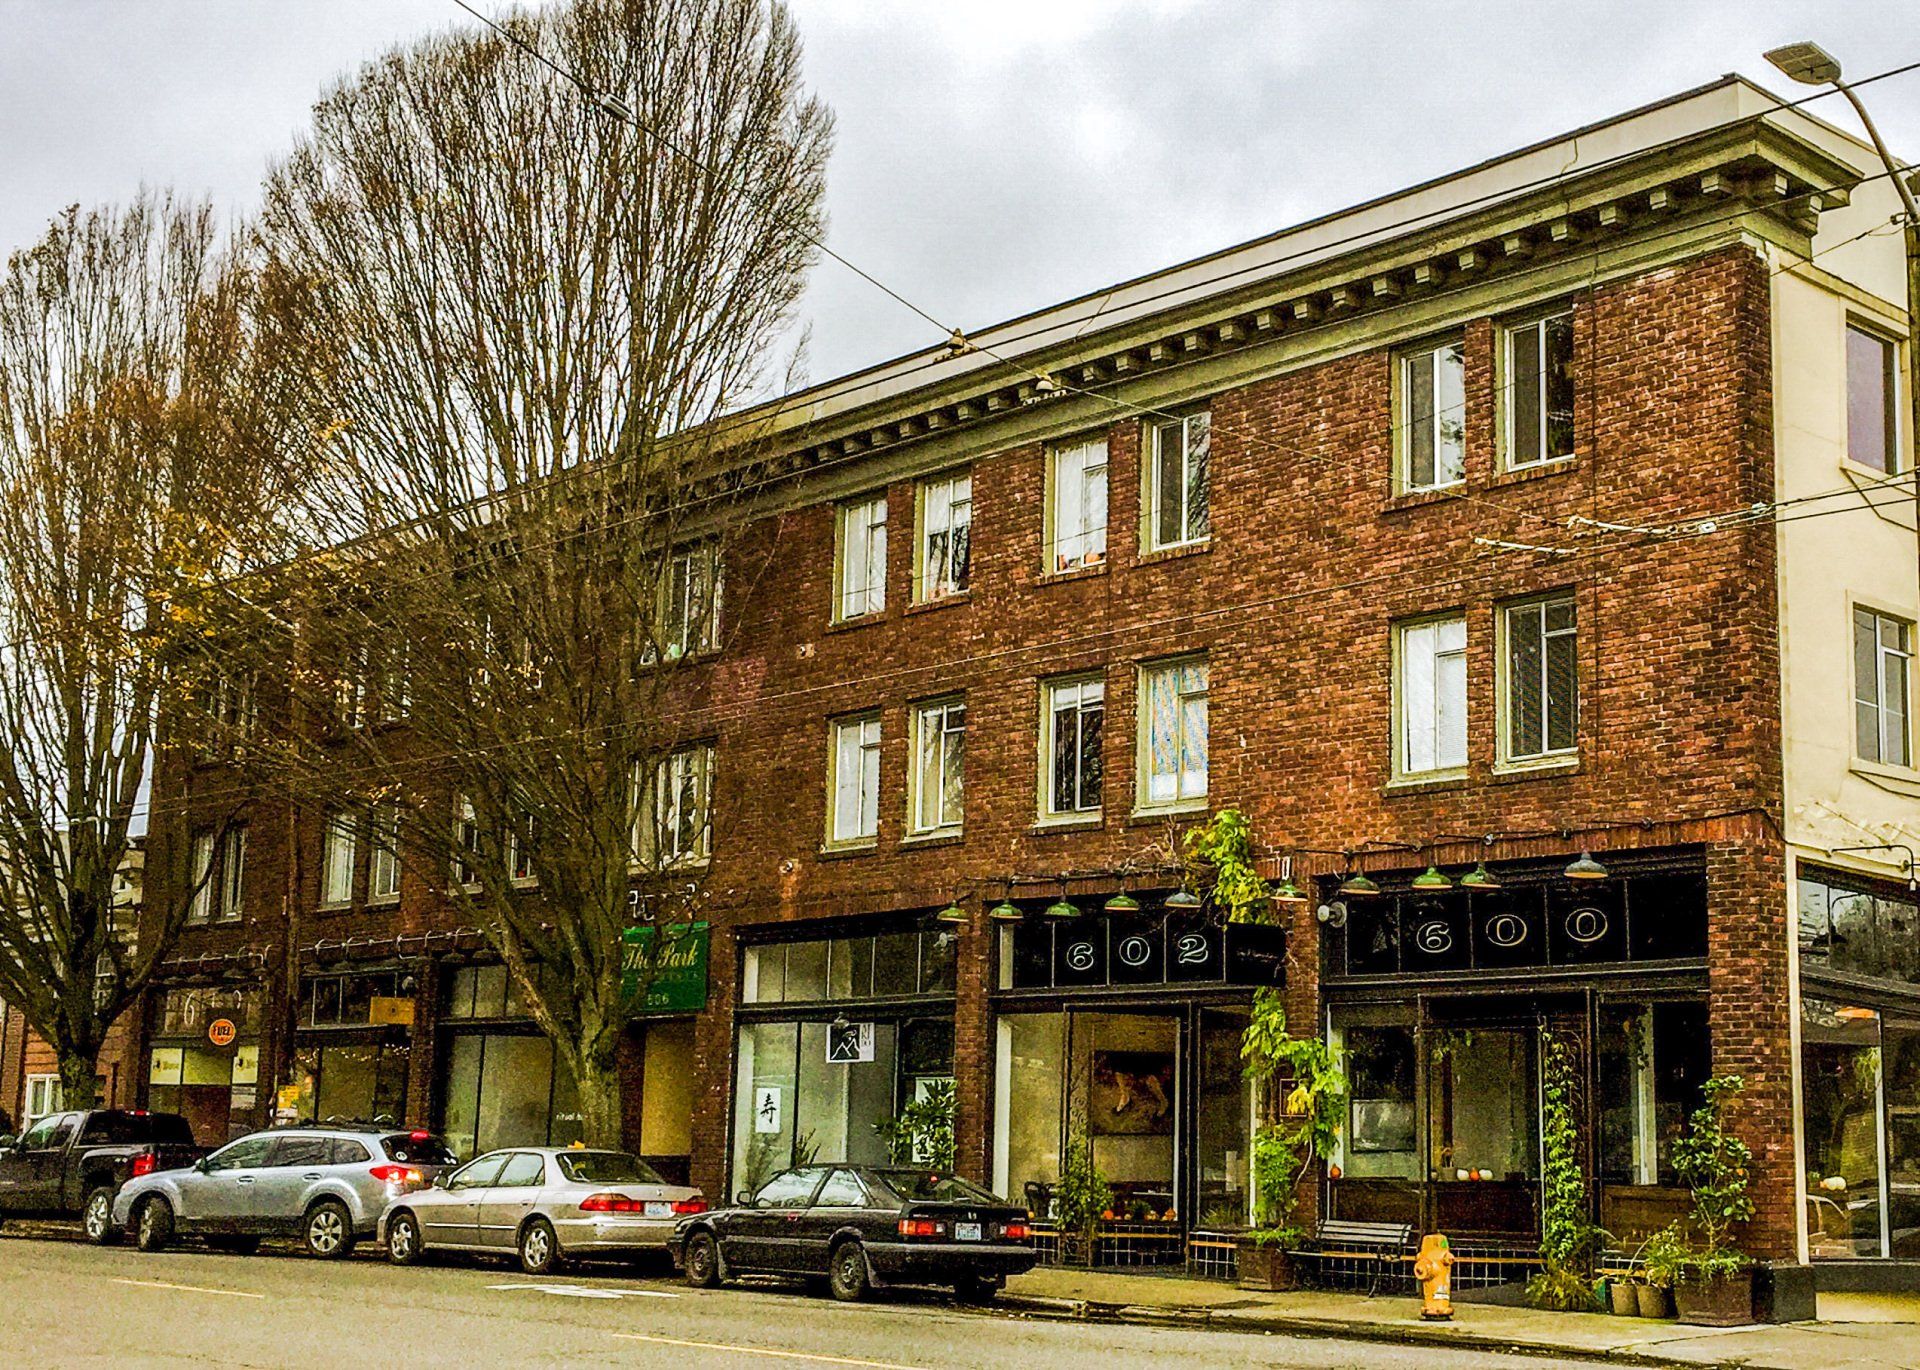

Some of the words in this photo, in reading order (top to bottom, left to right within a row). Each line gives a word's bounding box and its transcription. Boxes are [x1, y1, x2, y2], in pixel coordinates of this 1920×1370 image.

[1416, 907, 1608, 953] 600
[656, 939, 698, 968] Park
[1066, 934, 1209, 971] 602
[213, 1026, 231, 1036] FUEL
